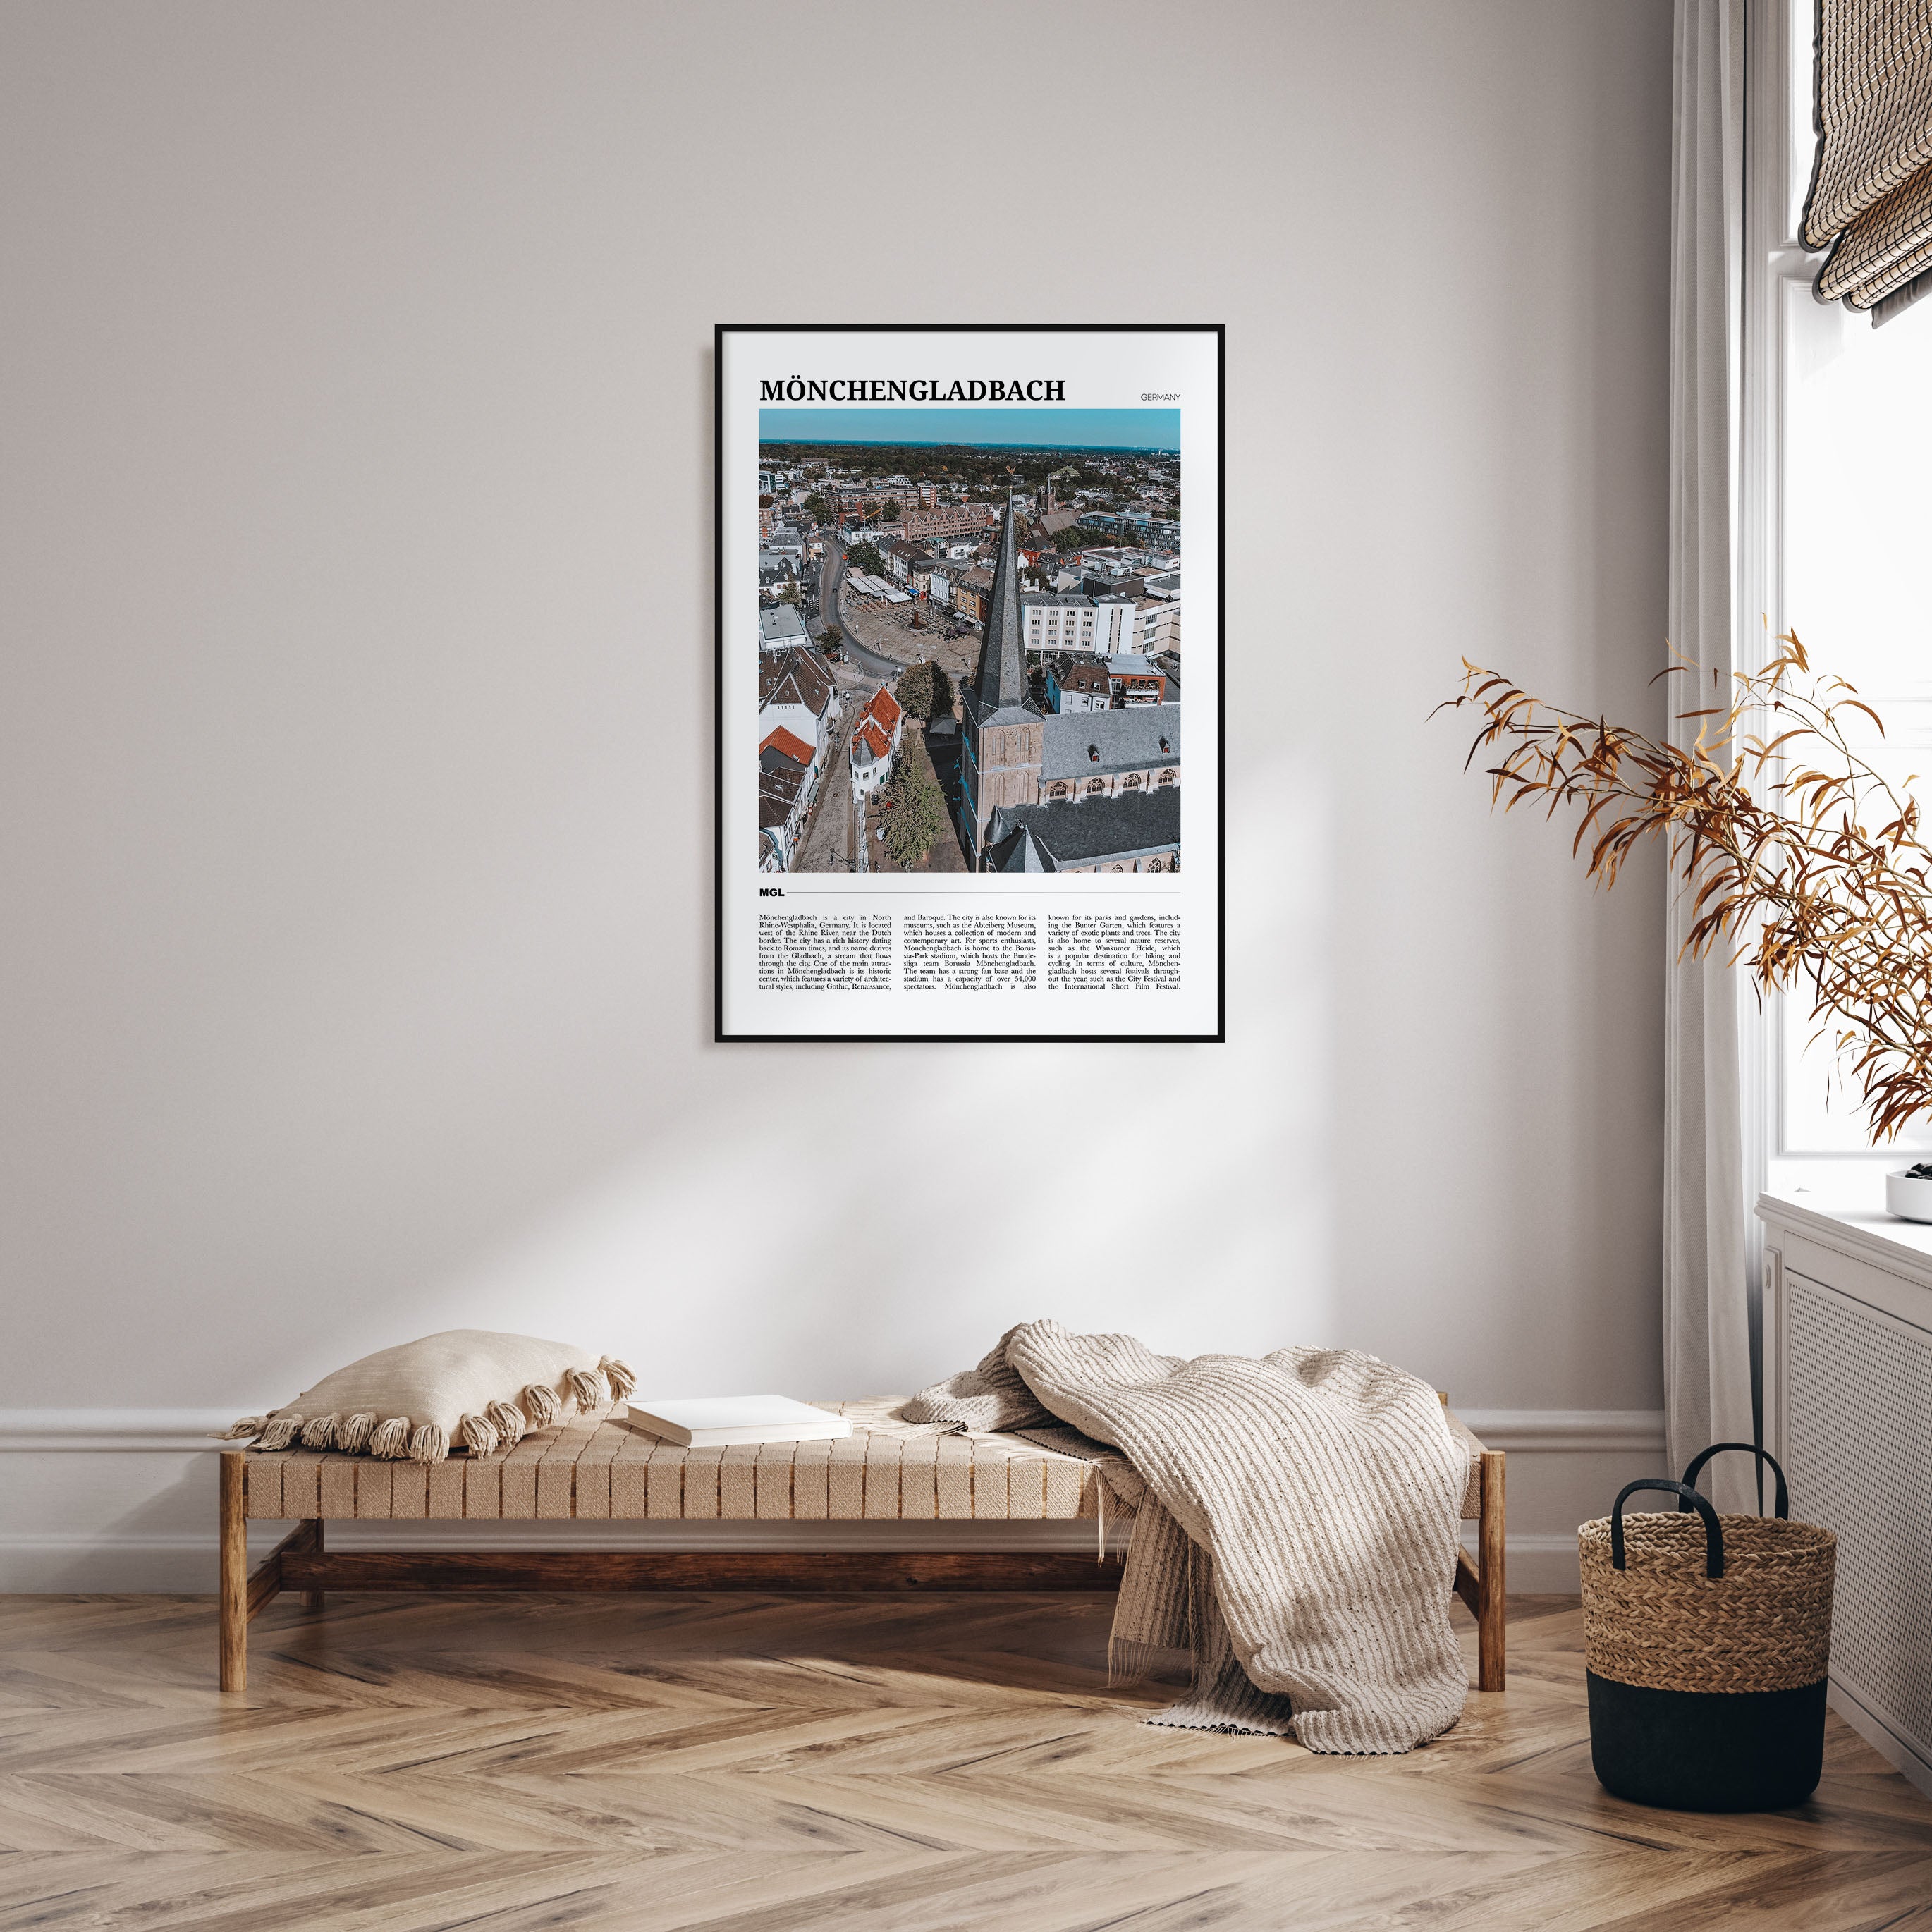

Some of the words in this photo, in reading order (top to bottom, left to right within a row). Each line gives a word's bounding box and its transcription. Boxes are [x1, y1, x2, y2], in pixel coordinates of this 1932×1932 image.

[759, 375, 1066, 401] MÖNCHENGLADBACH
[759, 888, 785, 897] MGL
[759, 922, 817, 930] Rhine-Westphalia,
[819, 922, 850, 930] Germany.
[974, 922, 1005, 930] Abteiberg
[1048, 922, 1058, 930] ing
[904, 945, 961, 953] Mönchengladbach
[1065, 953, 1090, 961] popular
[1145, 953, 1165, 961] hiking
[759, 960, 783, 969] through
[799, 960, 811, 969] city.
[904, 960, 917, 969] sliga
[977, 960, 1036, 969] Mönchengladbach.
[1048, 960, 1071, 969] cycling.
[788, 968, 845, 977] Mönchengladbach
[1048, 968, 1076, 977] gladbach
[1154, 968, 1180, 977] through-
[833, 976, 854, 984] variety
[955, 976, 982, 984] capacity
[776, 983, 793, 991] styles,
[796, 983, 825, 991] including
[945, 983, 1002, 991] Mönchengladbach
